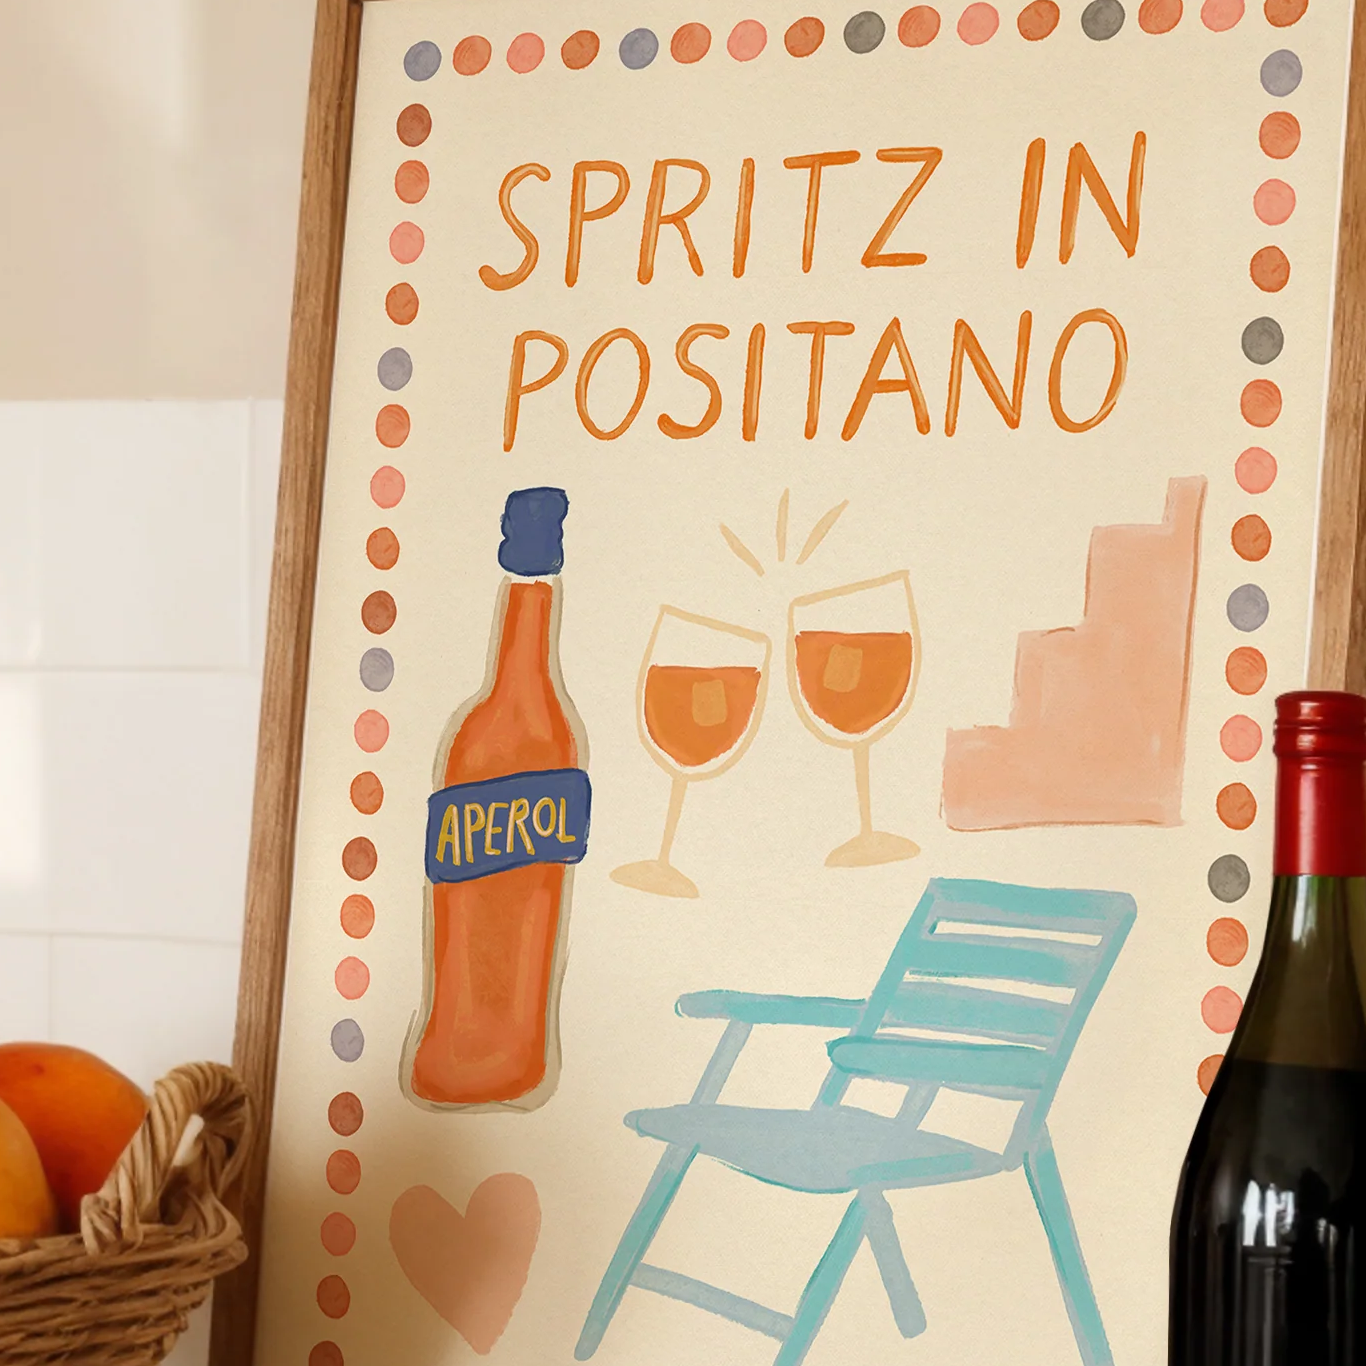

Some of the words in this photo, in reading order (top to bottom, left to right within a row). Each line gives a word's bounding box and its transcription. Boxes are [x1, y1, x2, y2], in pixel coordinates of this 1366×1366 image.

[478, 146, 943, 292] SPRITZ
[1015, 130, 1147, 270] IN
[502, 307, 1129, 453] POSITANO
[435, 796, 577, 866] APEROL
